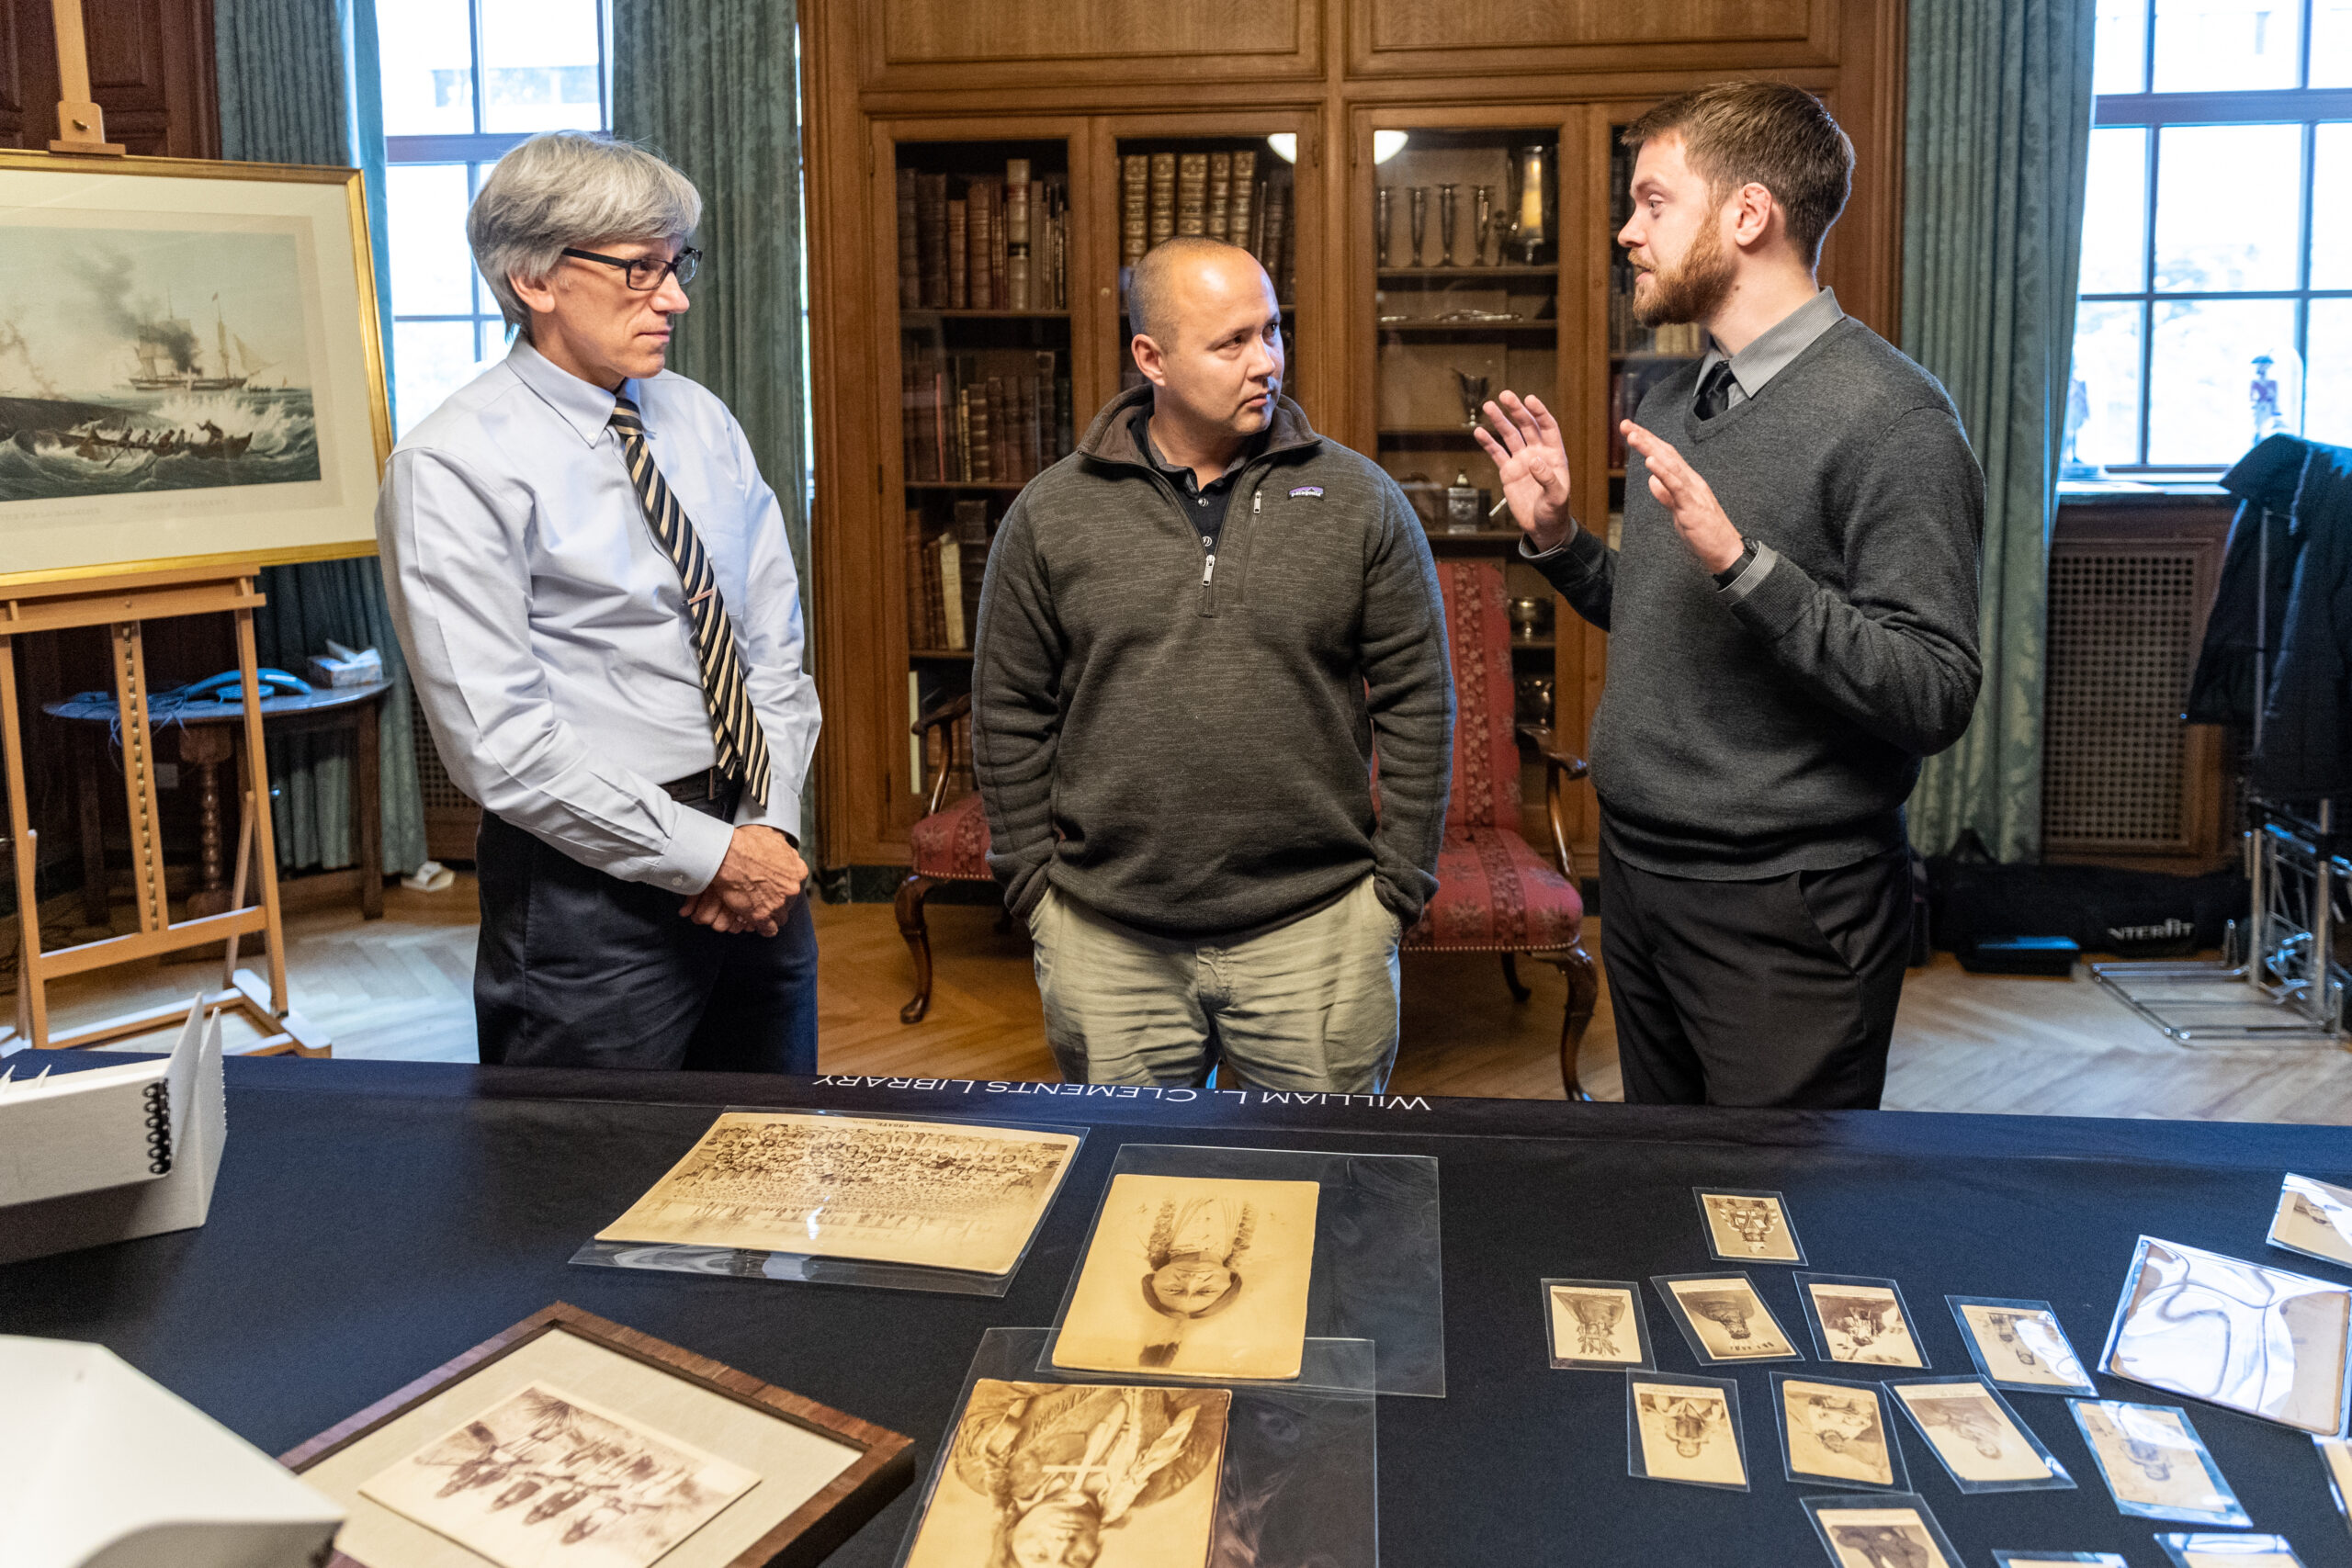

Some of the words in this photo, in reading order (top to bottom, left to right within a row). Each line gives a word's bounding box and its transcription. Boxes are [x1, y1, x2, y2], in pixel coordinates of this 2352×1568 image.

[812, 1075, 976, 1094] LIBRARY
[985, 1080, 1198, 1102] CLEMENTS
[1214, 1089, 1249, 1105] L.
[1261, 1091, 1431, 1111] WILLIAM
